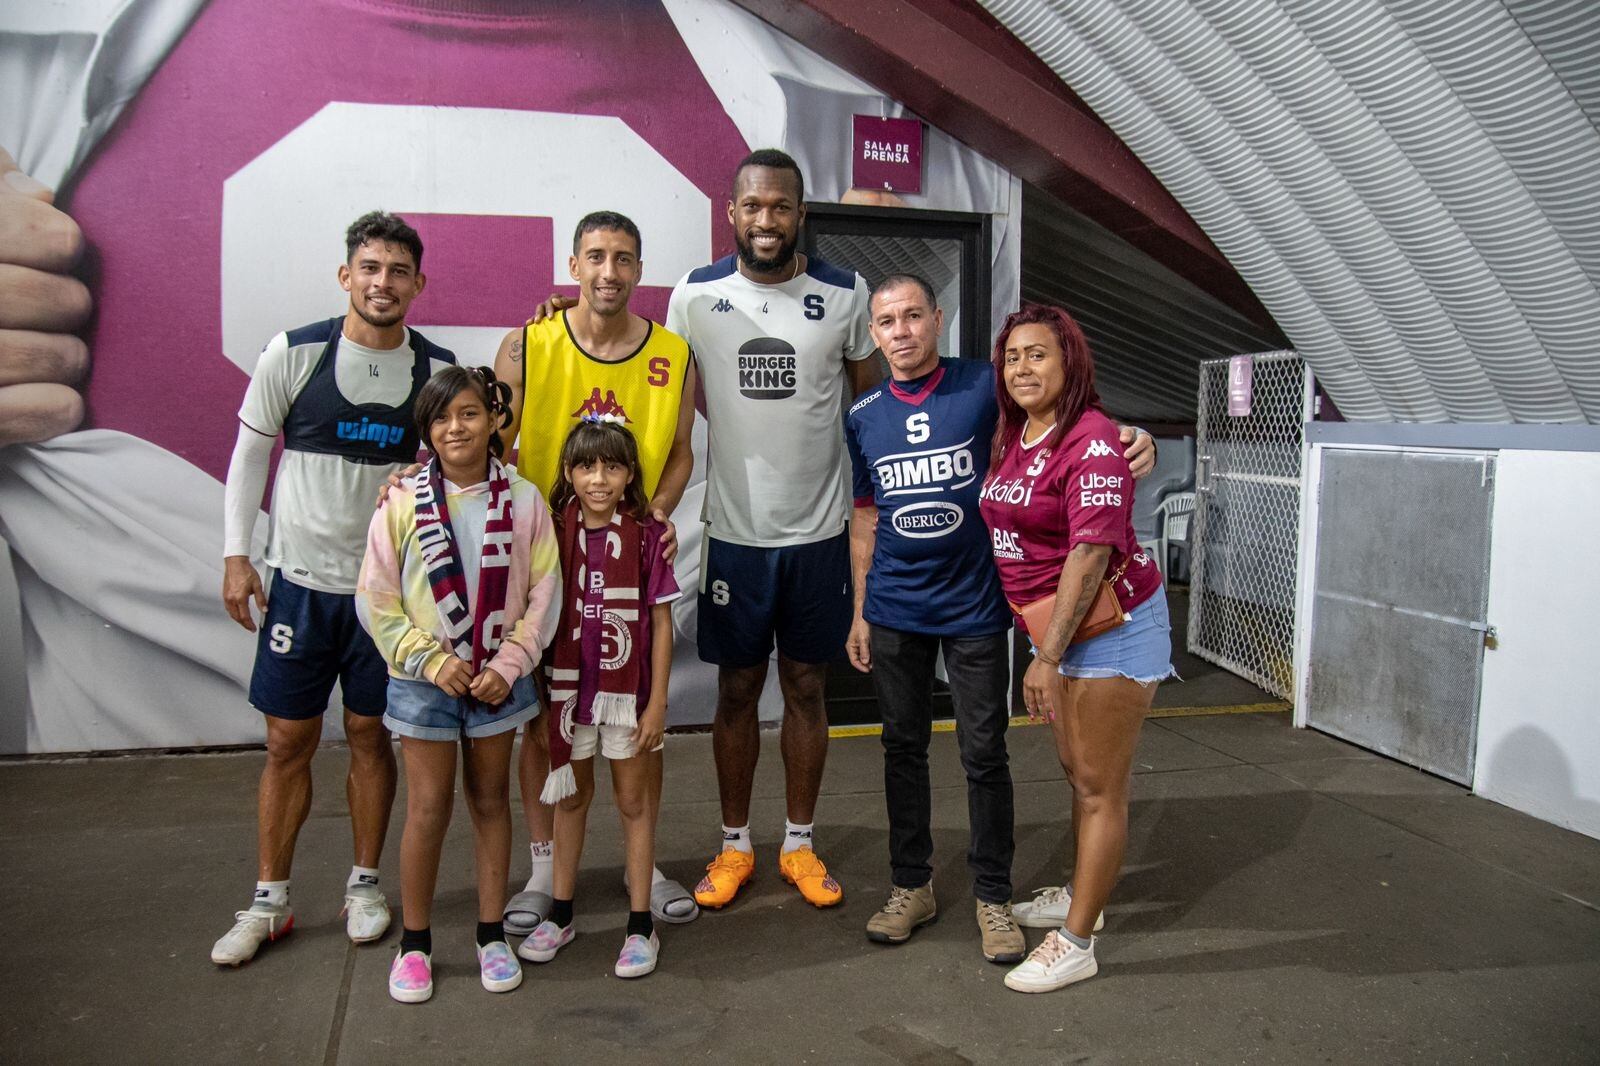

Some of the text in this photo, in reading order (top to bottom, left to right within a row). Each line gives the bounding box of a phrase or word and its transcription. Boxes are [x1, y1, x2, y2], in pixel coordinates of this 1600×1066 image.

[864, 140, 909, 153] SALA DE
[863, 149, 910, 164] PRENSA
[762, 301, 769, 315] 4
[803, 294, 825, 321] S
[369, 363, 380, 378] 14
[647, 356, 671, 387] S
[738, 356, 796, 370] BURGER
[739, 369, 797, 388] KING
[905, 411, 931, 445] S
[876, 448, 974, 491] BIMBO
[1026, 447, 1052, 477] S
[1080, 472, 1124, 490] Uber
[1080, 490, 1123, 508] Eats
[898, 510, 958, 529] IBERICO
[993, 527, 1024, 553] BAC
[712, 579, 731, 606] S
[269, 622, 294, 654] S
